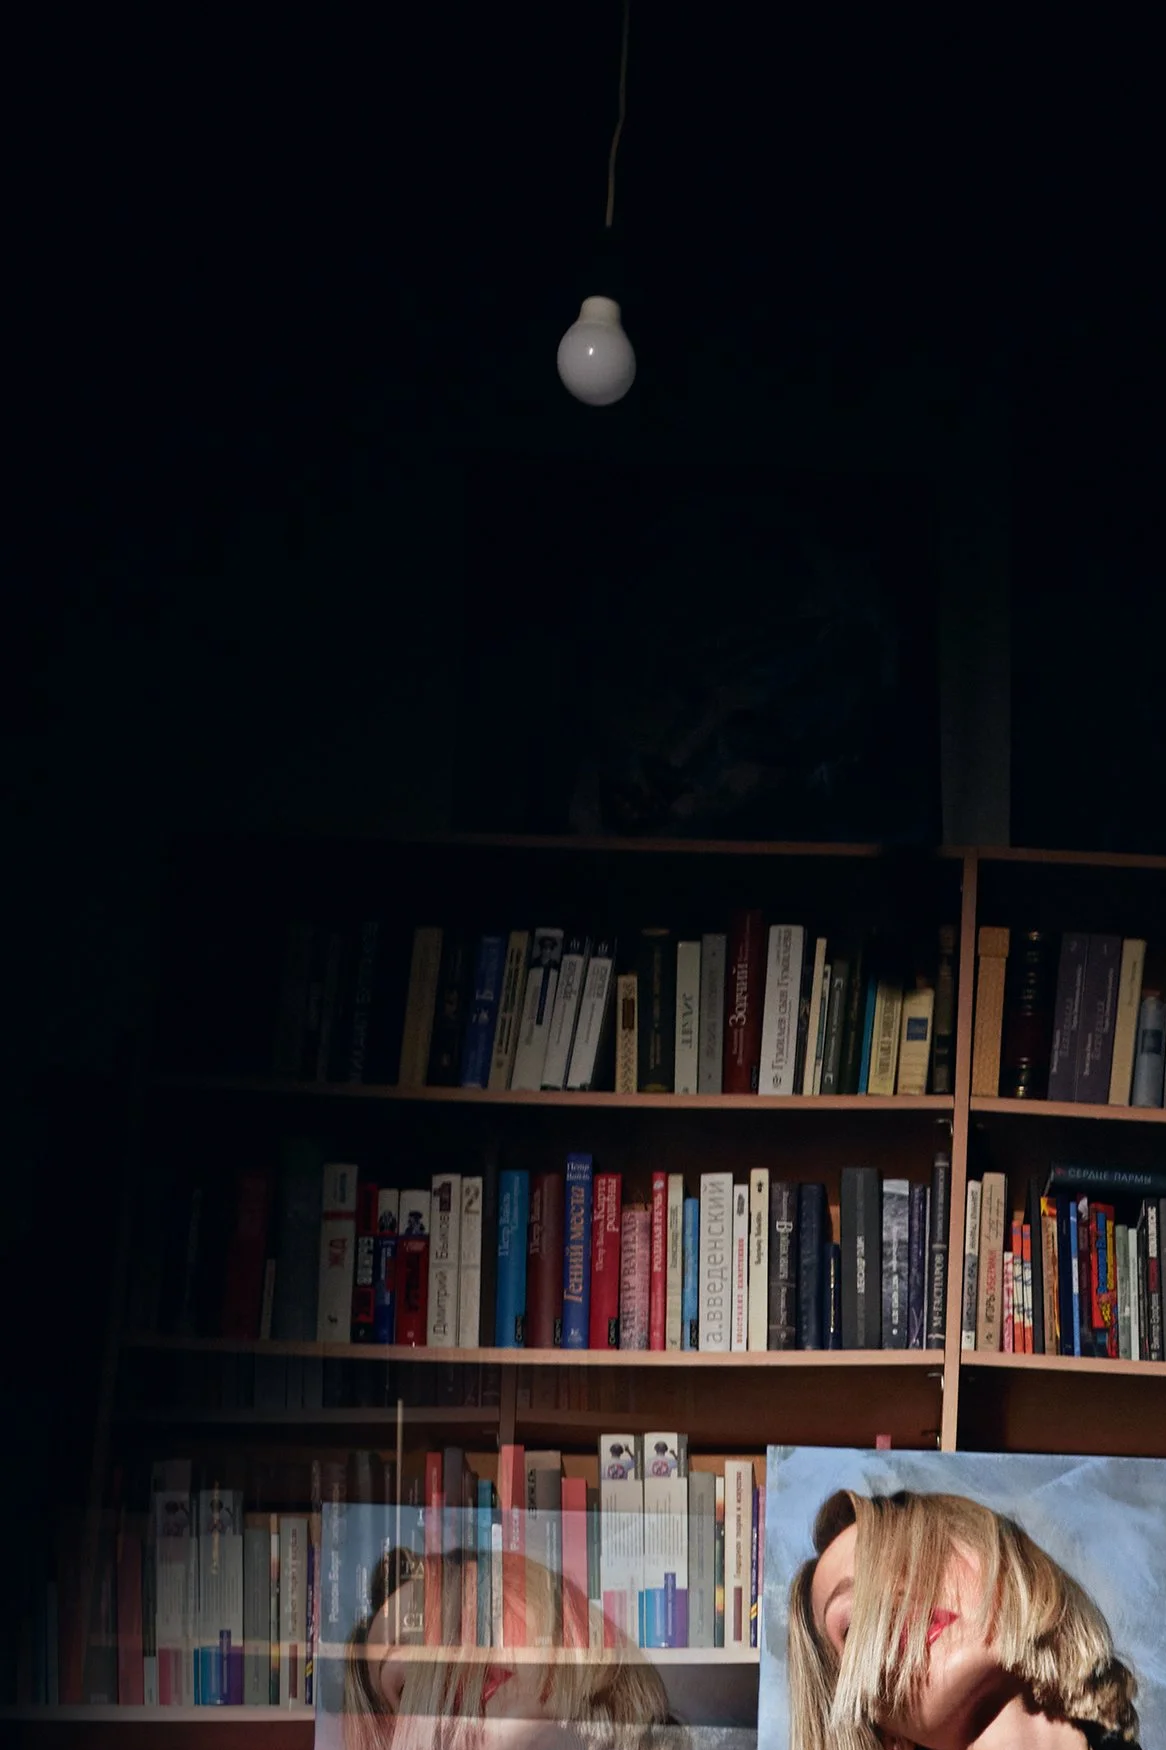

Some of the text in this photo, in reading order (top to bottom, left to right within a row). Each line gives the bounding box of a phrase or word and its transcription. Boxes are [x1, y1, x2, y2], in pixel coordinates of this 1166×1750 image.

[777, 928, 793, 988] Гумилева
[728, 963, 750, 1028] Зодчий
[772, 1018, 788, 1071] Гумилев
[464, 1186, 480, 1214] 2
[593, 1178, 606, 1220] Карта
[606, 1178, 620, 1232] родины
[1068, 1167, 1152, 1186] СЕРДЦЕ ПАРМЫ
[563, 1185, 585, 1303] Гений места
[653, 1192, 663, 1272] РОДНАЯ РЕЧЬ
[703, 1181, 728, 1344] а.введенский
[433, 1213, 450, 1336] Дмитрий Быков
[328, 1549, 342, 1624] Ролан Барт
